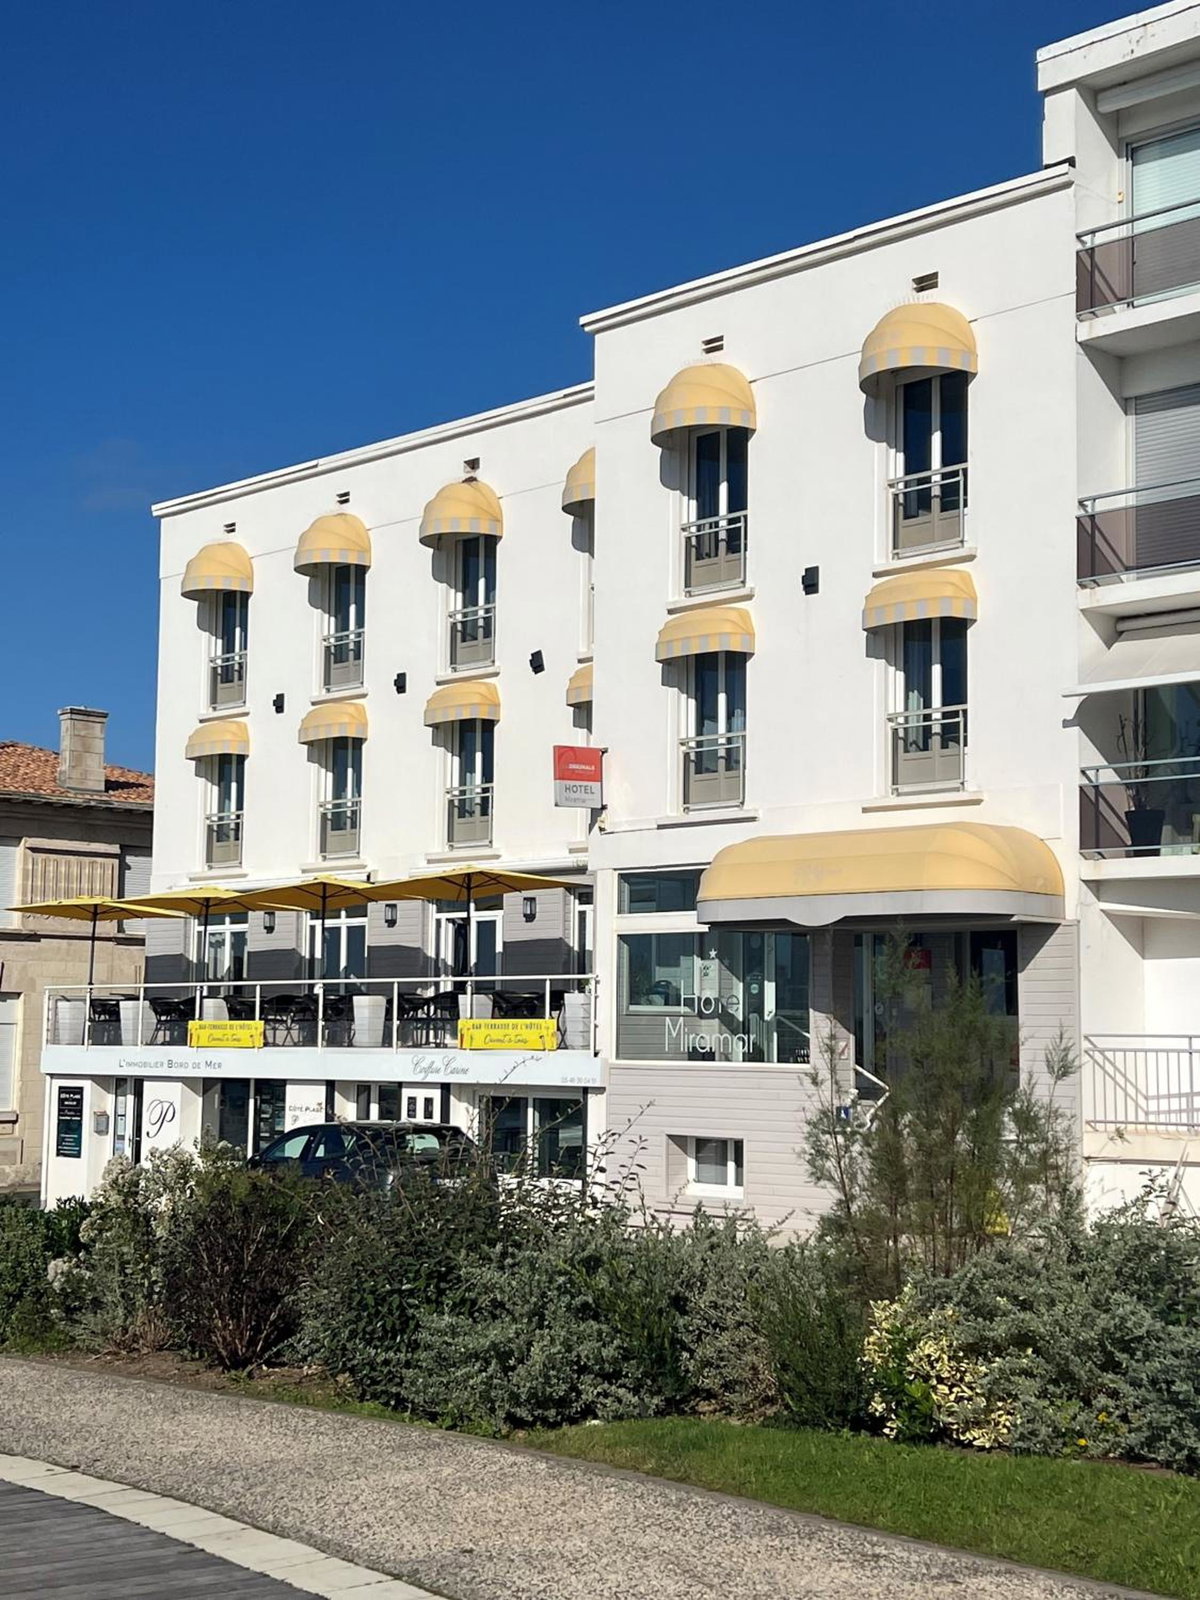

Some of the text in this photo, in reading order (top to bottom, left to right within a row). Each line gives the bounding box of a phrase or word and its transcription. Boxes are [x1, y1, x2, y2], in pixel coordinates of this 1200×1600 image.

[564, 784, 595, 795] HOTEL
[681, 979, 744, 1015] Hoe
[665, 1016, 756, 1053] Miramar
[146, 1099, 176, 1139] P
